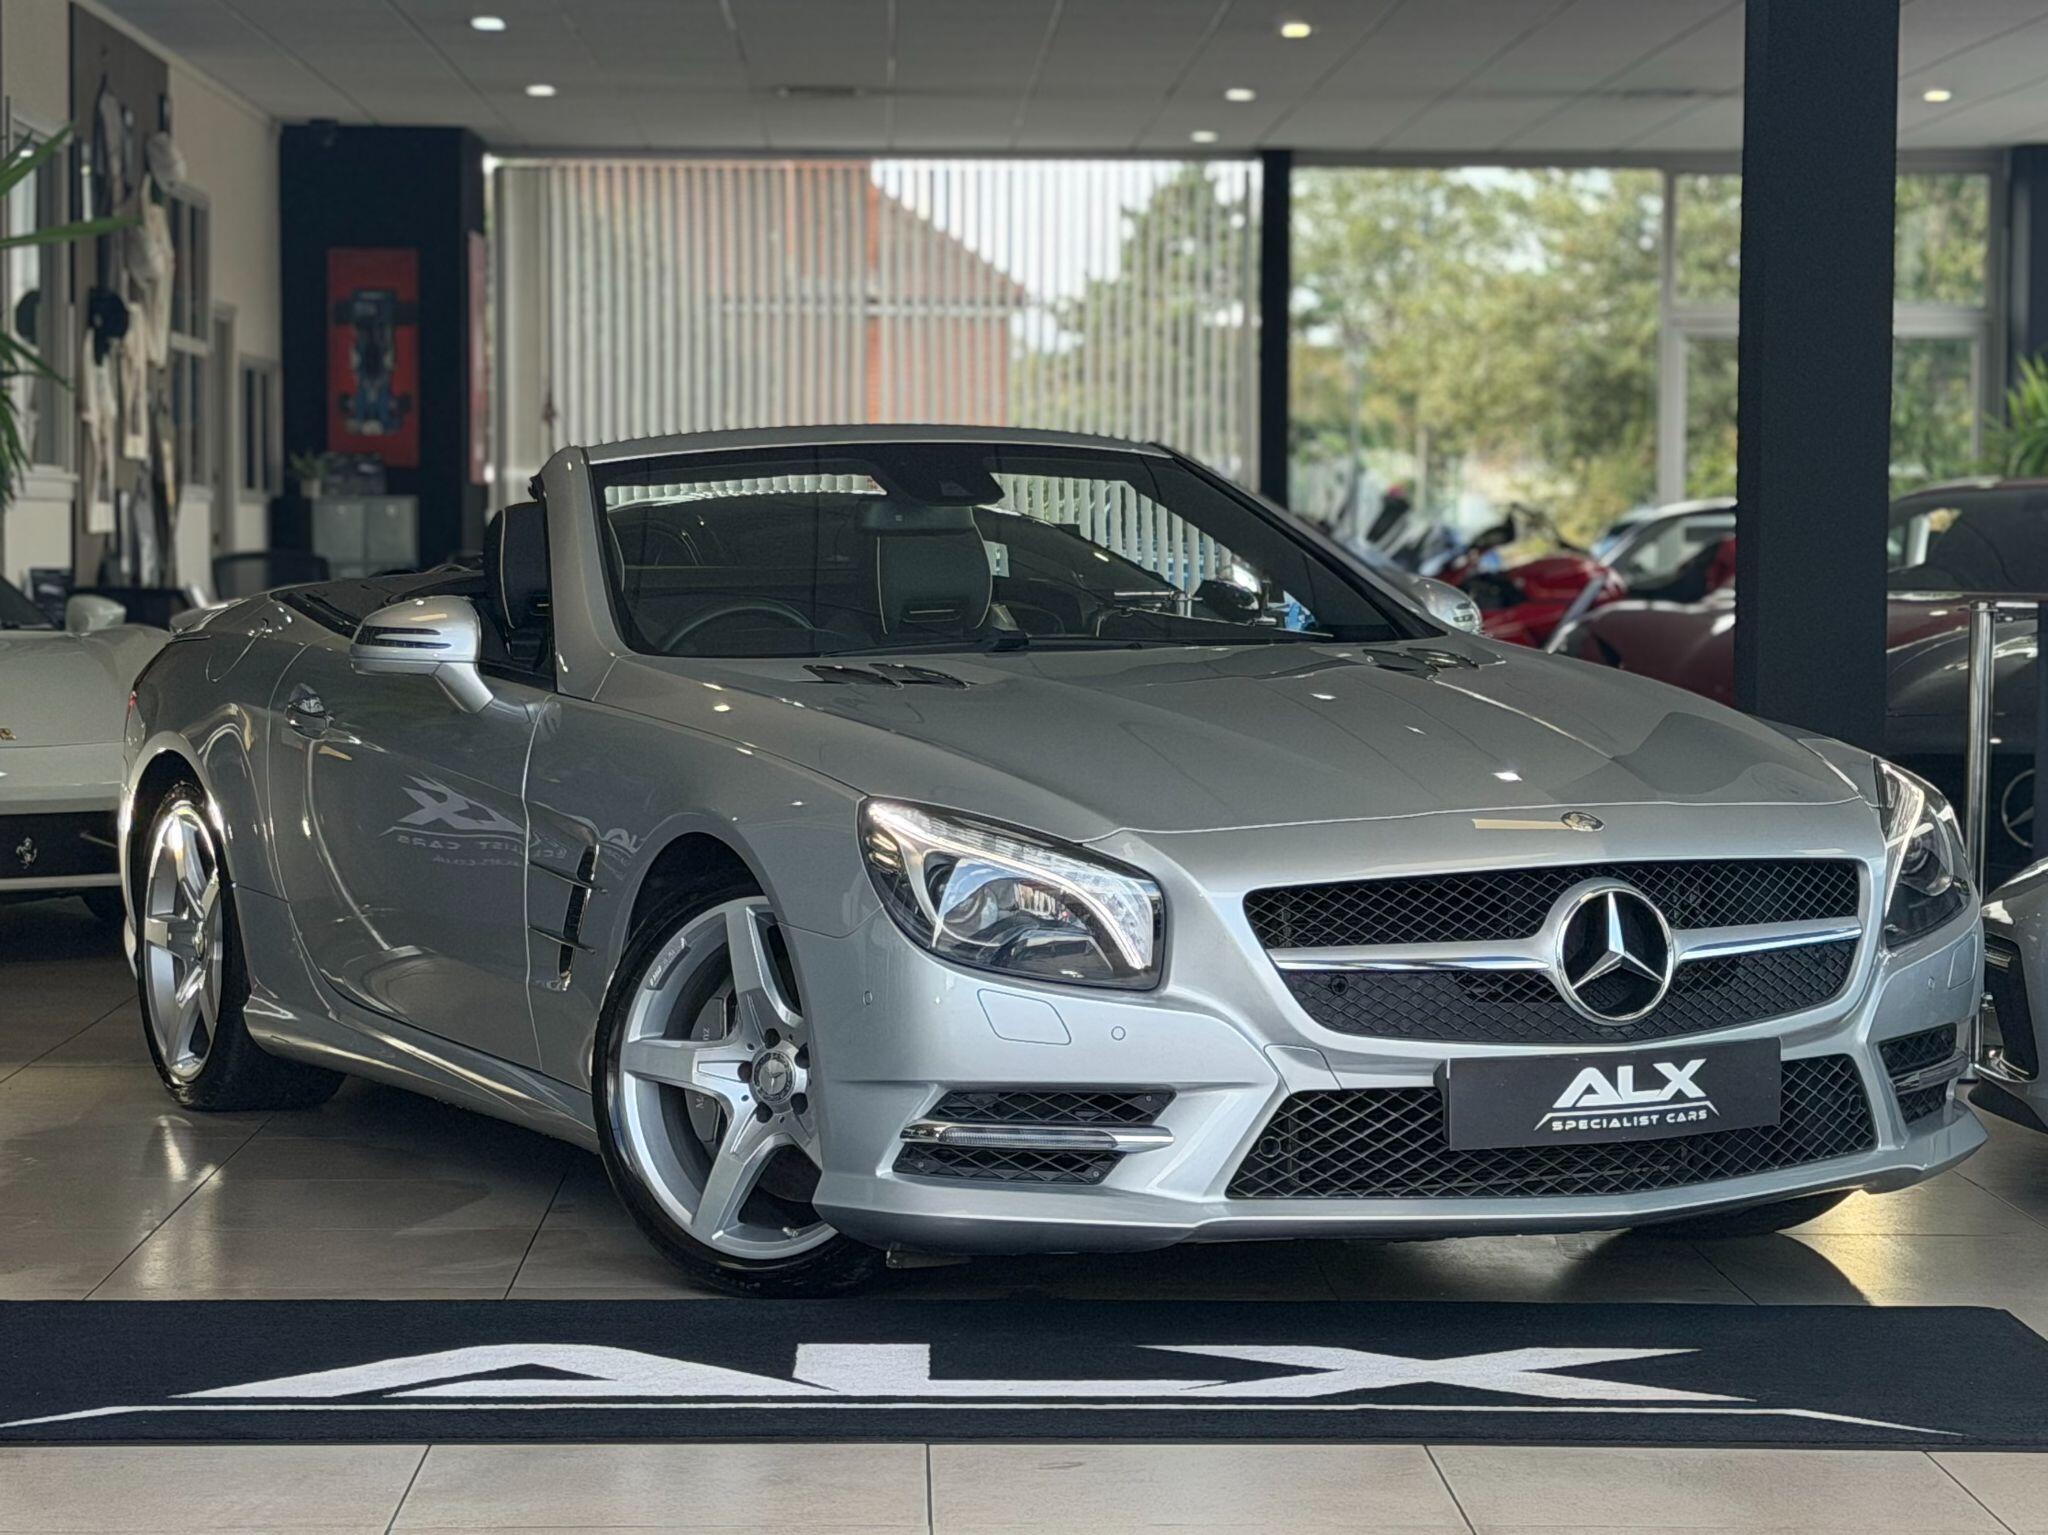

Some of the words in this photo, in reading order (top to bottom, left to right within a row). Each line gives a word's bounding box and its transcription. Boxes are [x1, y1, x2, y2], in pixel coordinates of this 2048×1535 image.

[1552, 1058, 1707, 1109] ALX
[1551, 1114, 1660, 1131] SPECIALIST
[1665, 1109, 1708, 1124] CARS
[169, 1343, 1757, 1401] ALX
